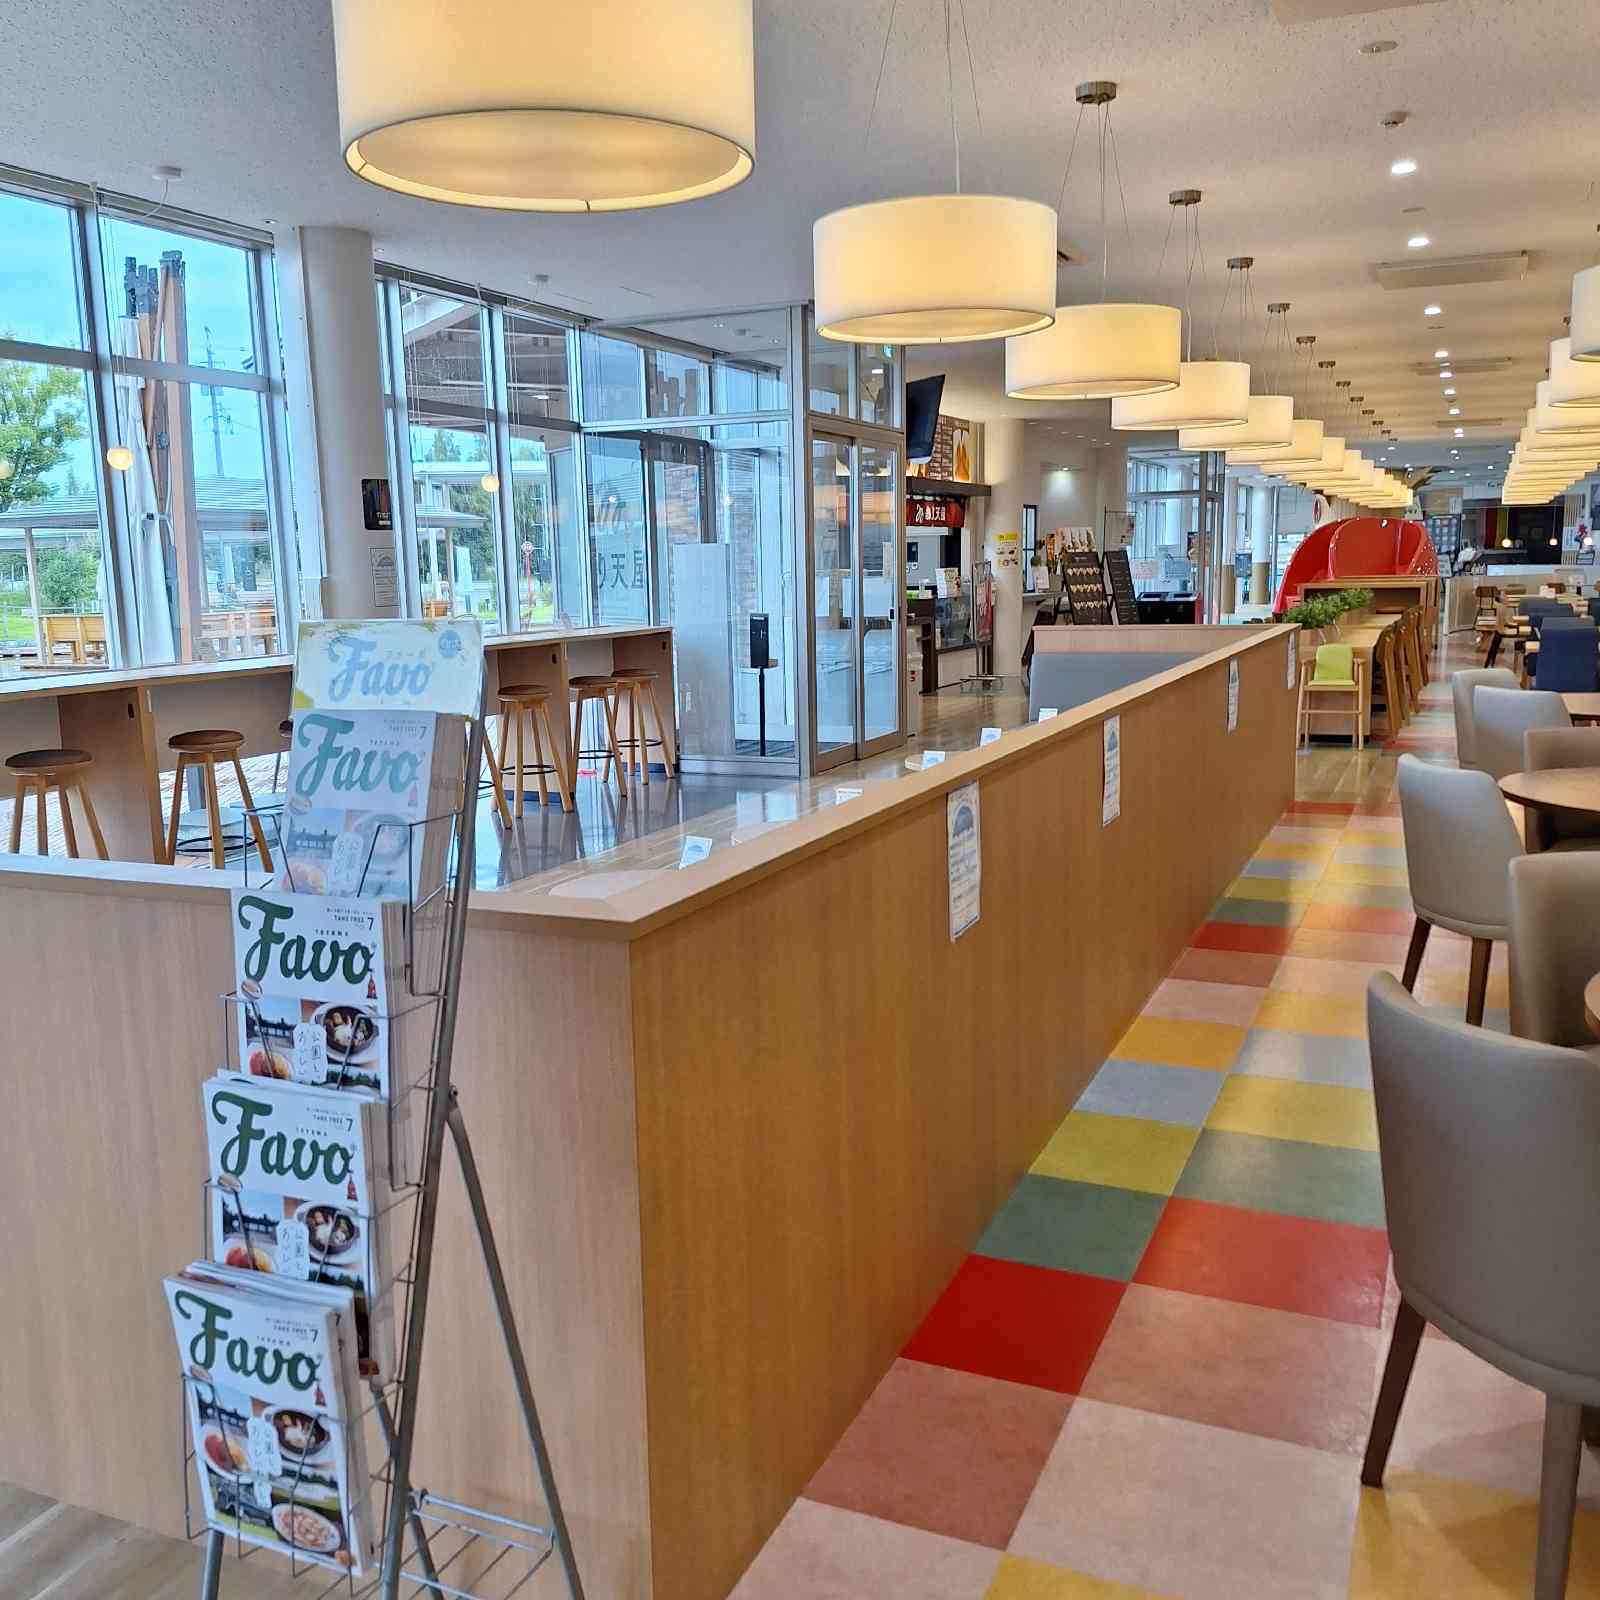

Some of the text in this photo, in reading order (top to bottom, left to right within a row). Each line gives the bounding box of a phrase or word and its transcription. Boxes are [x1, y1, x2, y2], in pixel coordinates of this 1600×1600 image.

[328, 636, 432, 702] Favo
[295, 713, 423, 798] Favo
[238, 895, 374, 985] Favo
[367, 916, 374, 931] 7
[211, 1090, 353, 1185] Favo
[345, 1117, 353, 1132] 7
[175, 1289, 320, 1392] Favo
[309, 1328, 318, 1343] 7
